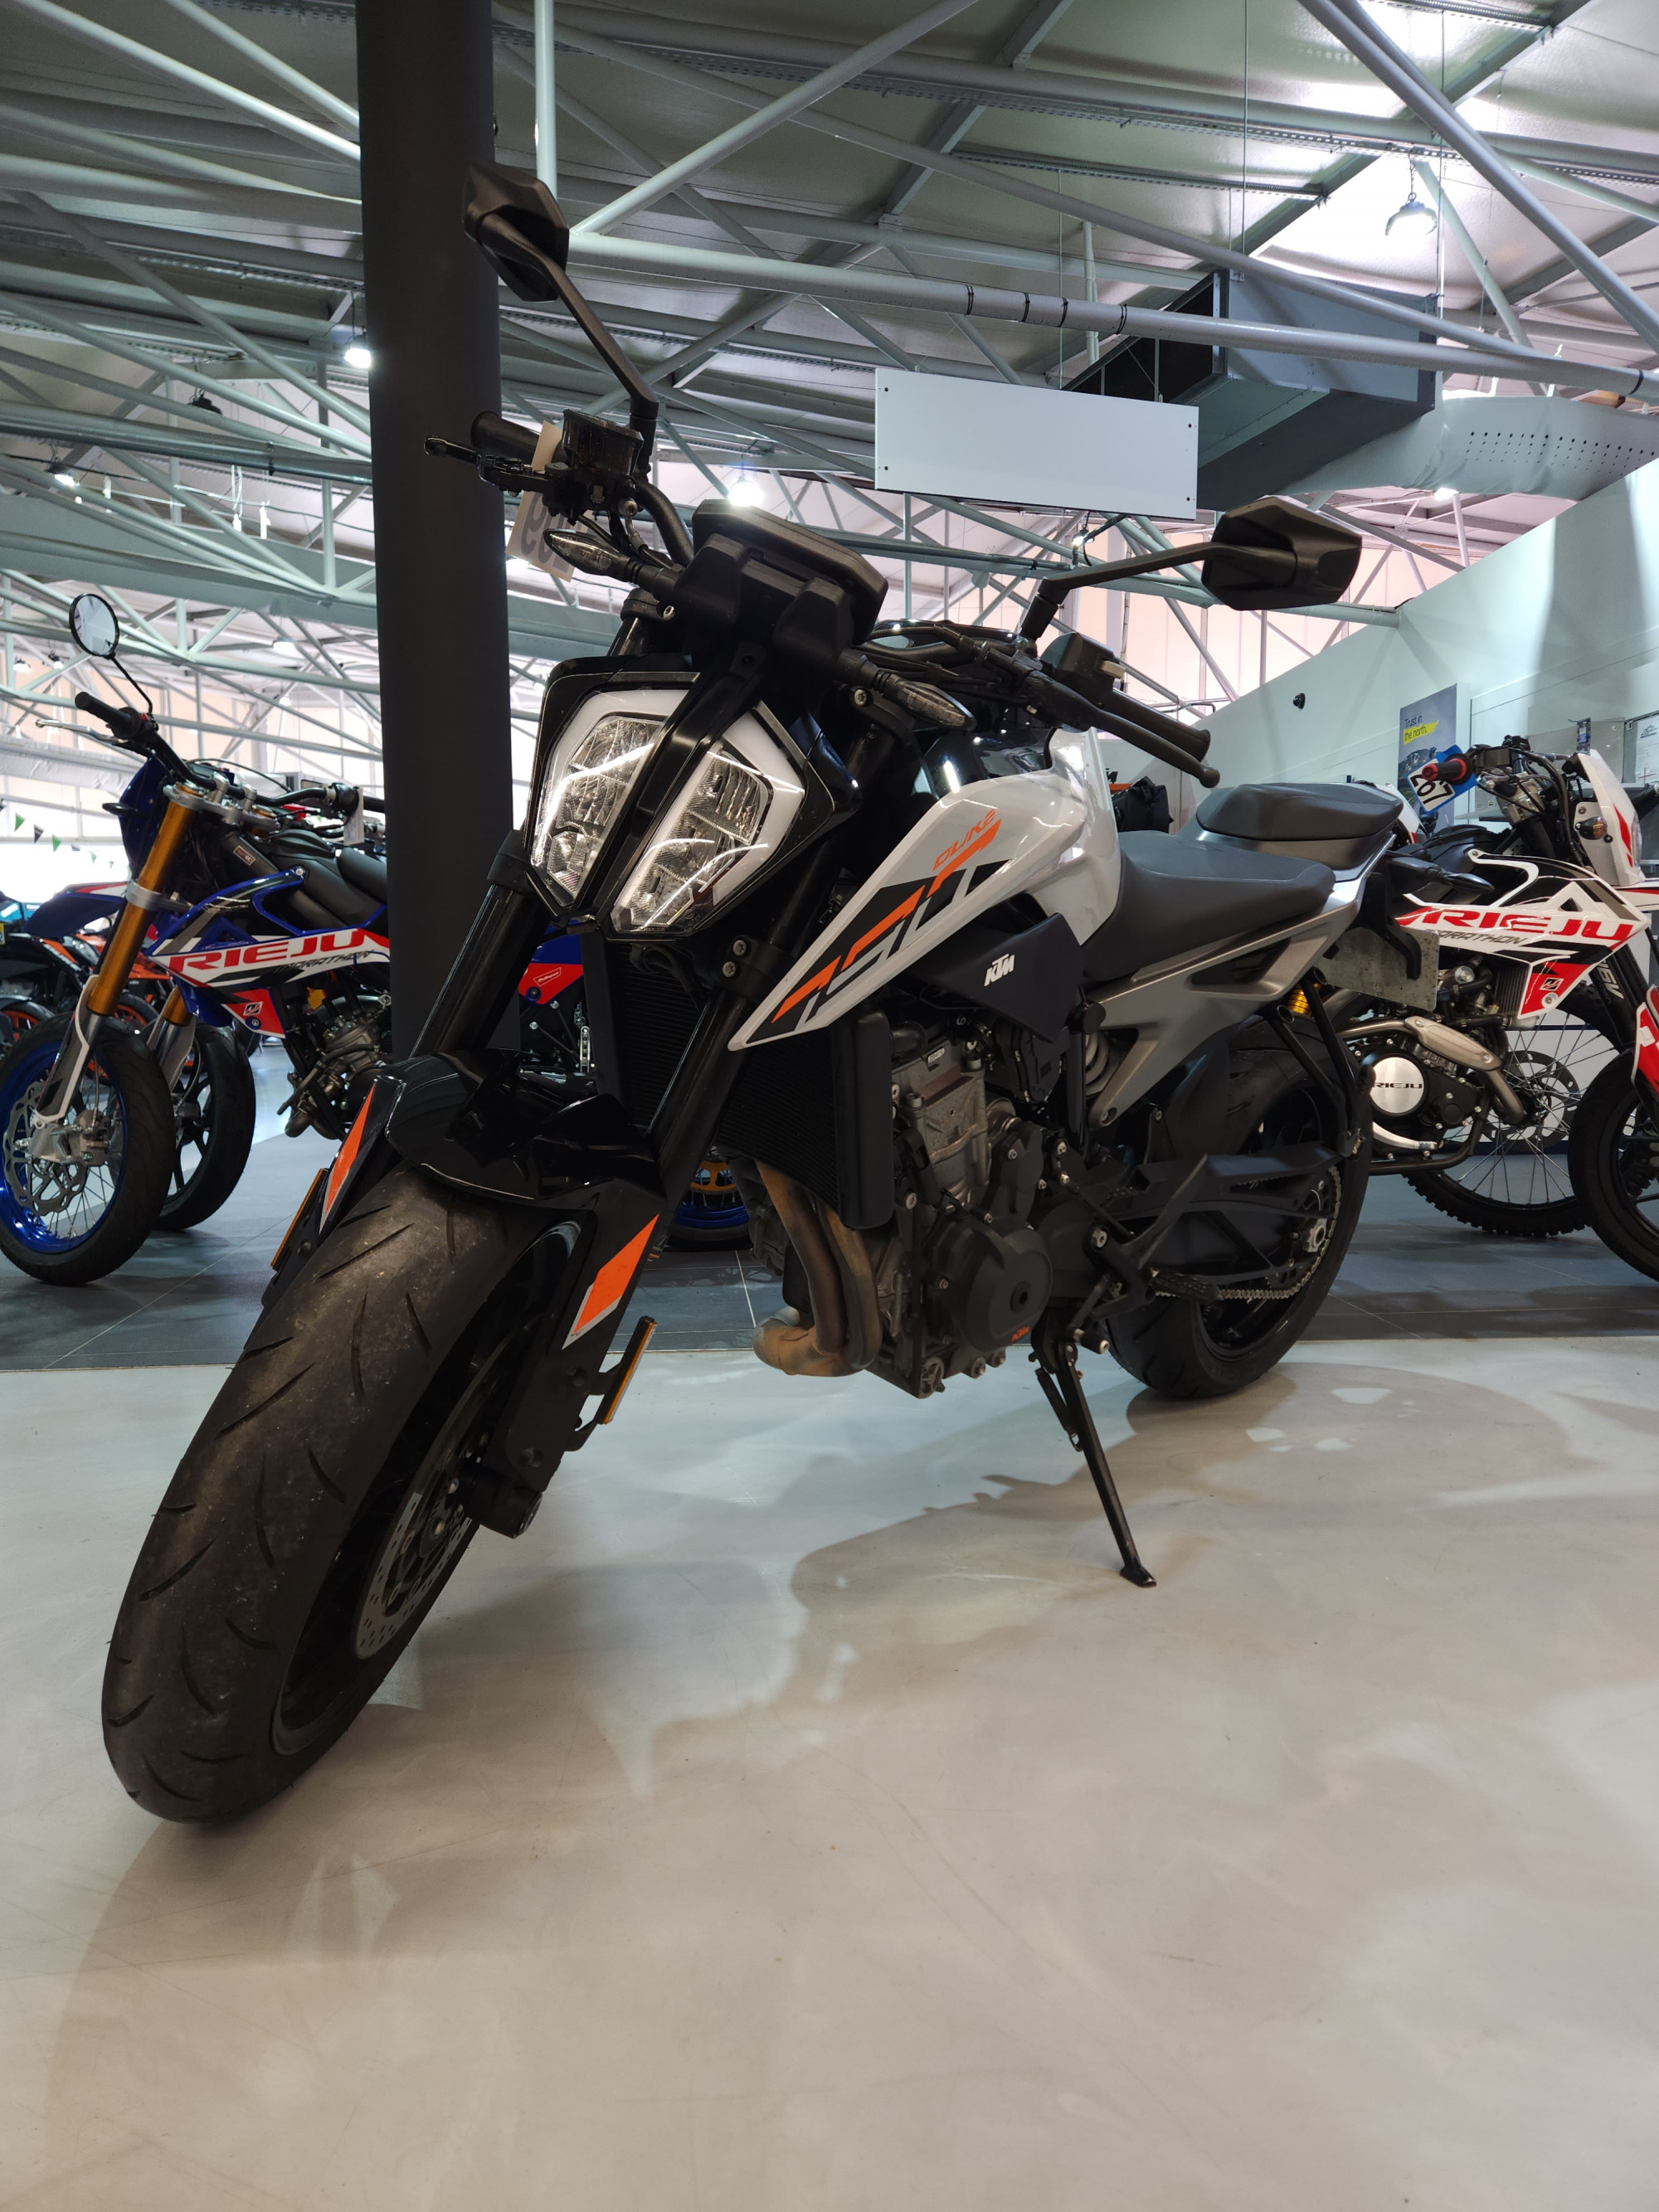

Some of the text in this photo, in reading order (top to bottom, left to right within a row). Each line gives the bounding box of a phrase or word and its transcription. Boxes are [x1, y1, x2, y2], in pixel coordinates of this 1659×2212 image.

[1405, 714, 1422, 728] Trust in
[932, 809, 995, 872] DUKE
[1422, 909, 1634, 941] RIEJU
[1426, 929, 1527, 944] ARATHON
[168, 928, 366, 973] RIEJU
[984, 954, 1014, 986] KTM
